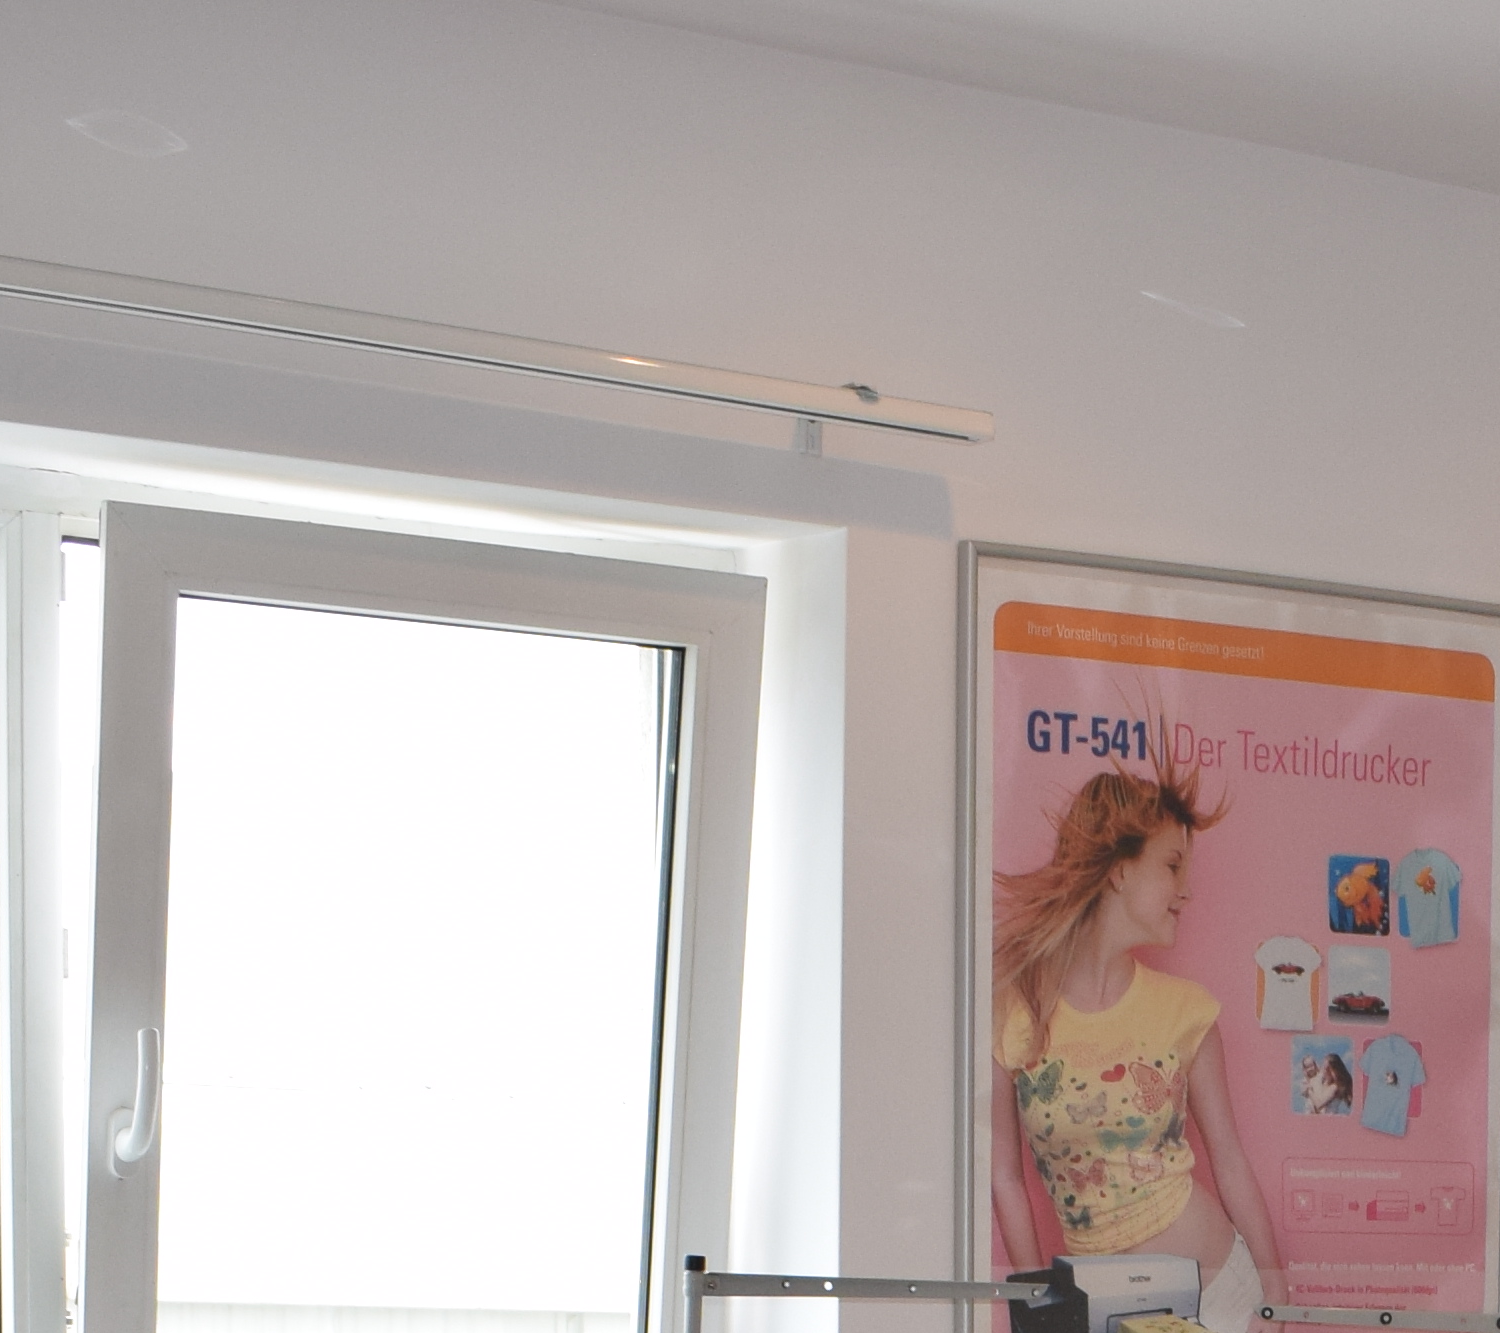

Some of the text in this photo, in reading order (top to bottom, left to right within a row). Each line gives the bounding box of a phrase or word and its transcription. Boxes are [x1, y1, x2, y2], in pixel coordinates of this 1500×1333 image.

[1027, 620, 1265, 661] Ihrer Vorstellung sind keine Grenzen gesetzt!
[1027, 709, 1148, 761] GT-541
[1174, 722, 1433, 788] Der Textildrucker
